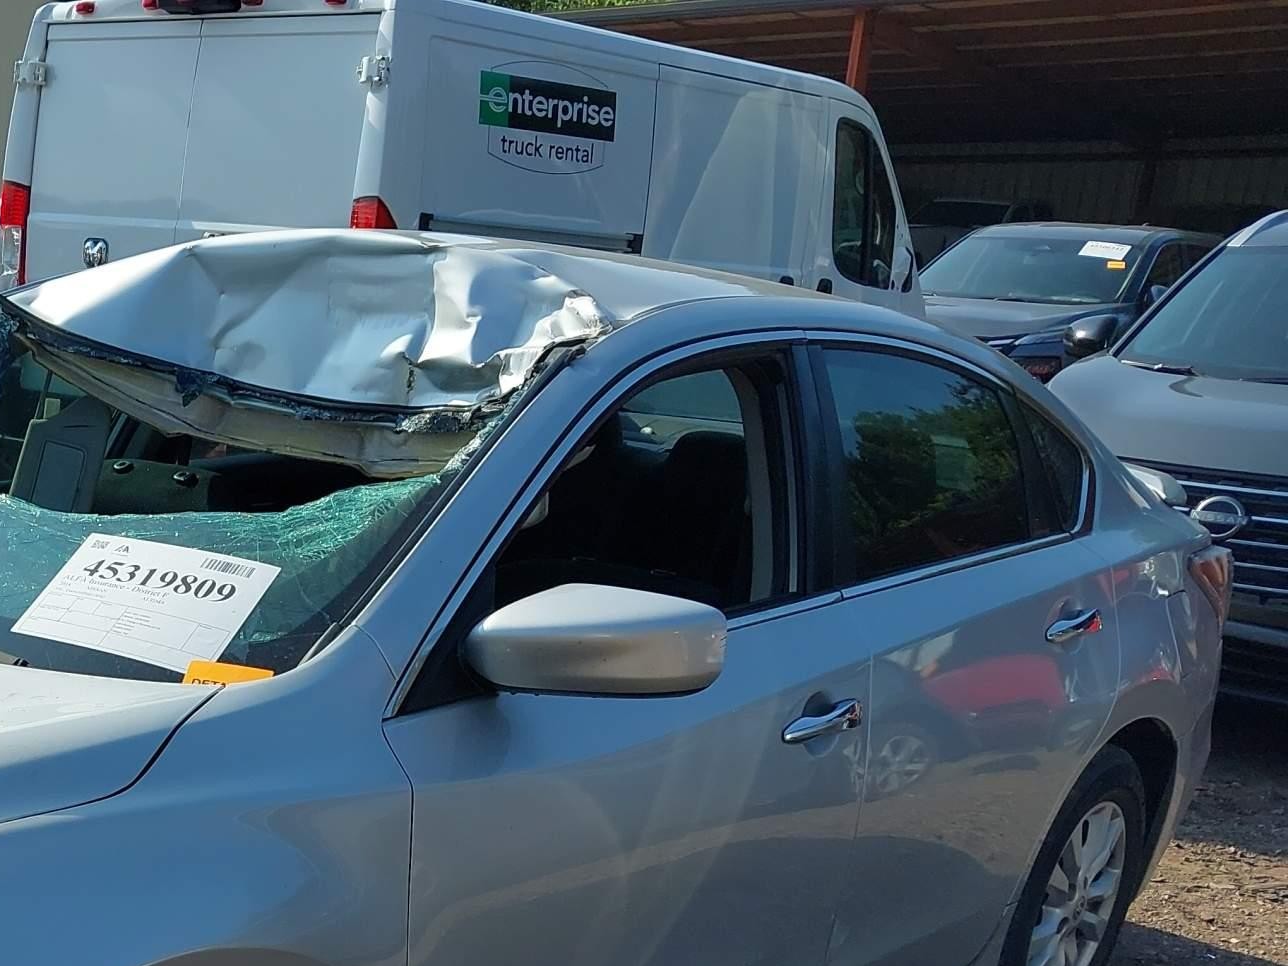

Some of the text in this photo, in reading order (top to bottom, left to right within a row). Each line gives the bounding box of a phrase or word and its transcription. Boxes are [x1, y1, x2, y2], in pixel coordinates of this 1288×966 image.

[486, 87, 614, 128] enterprise
[500, 135, 594, 164] truck rental
[83, 559, 237, 602] 45319809
[88, 578, 125, 590] Insurance
[131, 585, 162, 598] District
